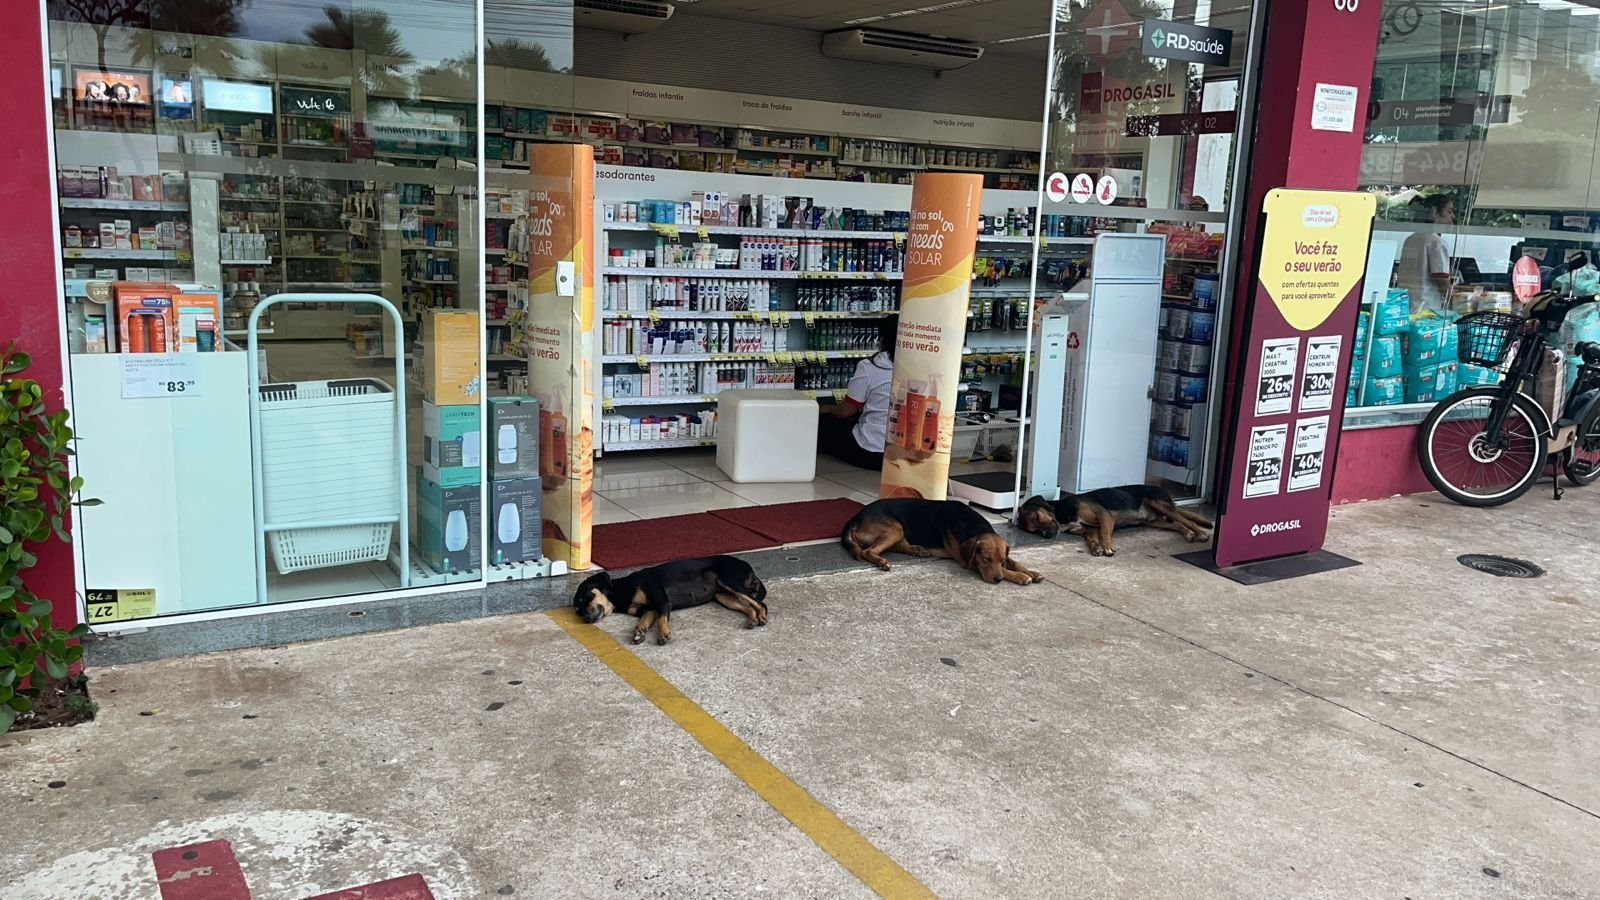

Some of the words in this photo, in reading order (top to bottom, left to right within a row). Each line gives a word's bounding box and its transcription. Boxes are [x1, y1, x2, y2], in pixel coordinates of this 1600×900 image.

[632, 89, 657, 99] fraldas
[658, 91, 684, 101] infantis
[1104, 83, 1175, 103] DROGASIL
[743, 100, 760, 109] troca
[770, 102, 793, 111] fraldas
[842, 109, 860, 118] banho
[861, 110, 882, 120] infantil
[1393, 107, 1409, 120] 04
[1415, 111, 1450, 119] preferencial
[933, 118, 955, 127] nutrição
[956, 120, 975, 128] infantil
[1204, 117, 1217, 129] 02
[596, 169, 655, 182] esodorantes
[917, 211, 926, 220] no
[928, 210, 944, 223] sol,
[916, 223, 929, 231] com
[910, 229, 944, 250] needs
[530, 240, 553, 256] OLAR
[1294, 240, 1321, 255] Você
[1322, 240, 1338, 255] faz
[908, 250, 943, 266] SOLAR
[1284, 262, 1292, 272] o
[1293, 262, 1312, 272] seu
[1313, 257, 1342, 272] verão
[1295, 280, 1316, 288] ofertas
[1317, 281, 1340, 289] quentes
[1281, 293, 1294, 301] para
[1294, 291, 1308, 300] você
[915, 321, 942, 334] imediata
[914, 332, 941, 342] momento
[536, 347, 560, 360] verão
[902, 341, 914, 350] seu
[916, 342, 940, 353] verão
[1264, 359, 1288, 368] CREATINE
[1309, 353, 1331, 361] CENTRUM
[1267, 376, 1291, 394] 26%
[1310, 374, 1332, 390] 30%
[1254, 436, 1274, 444] NUTREN
[1298, 434, 1320, 442] CREATINA
[1255, 460, 1279, 476] 25%
[1298, 454, 1321, 470] 40%
[1259, 519, 1302, 534] DROGASIL
